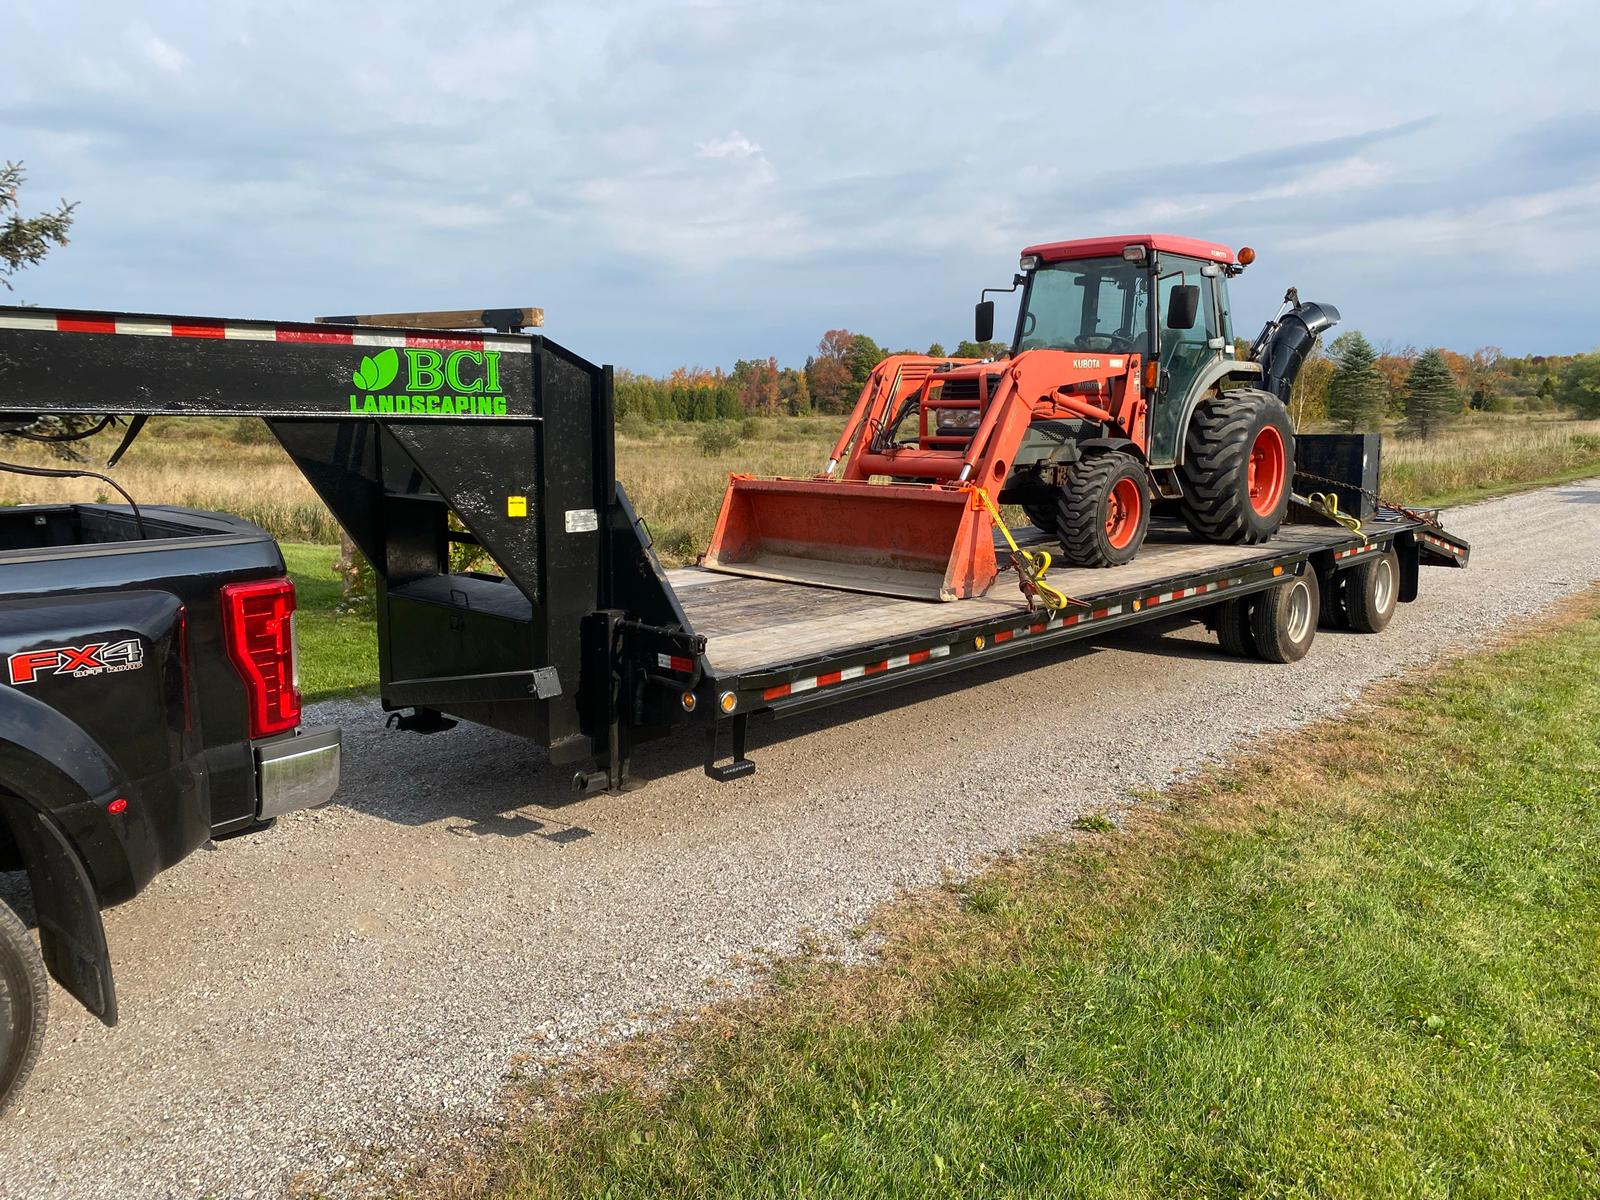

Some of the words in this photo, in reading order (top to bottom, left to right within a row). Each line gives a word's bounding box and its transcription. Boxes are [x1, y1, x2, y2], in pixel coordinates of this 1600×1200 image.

[404, 348, 502, 393] BCI
[1072, 359, 1101, 369] KUBOTA
[350, 394, 507, 416] LANDSCAPING
[7, 638, 144, 685] FX4
